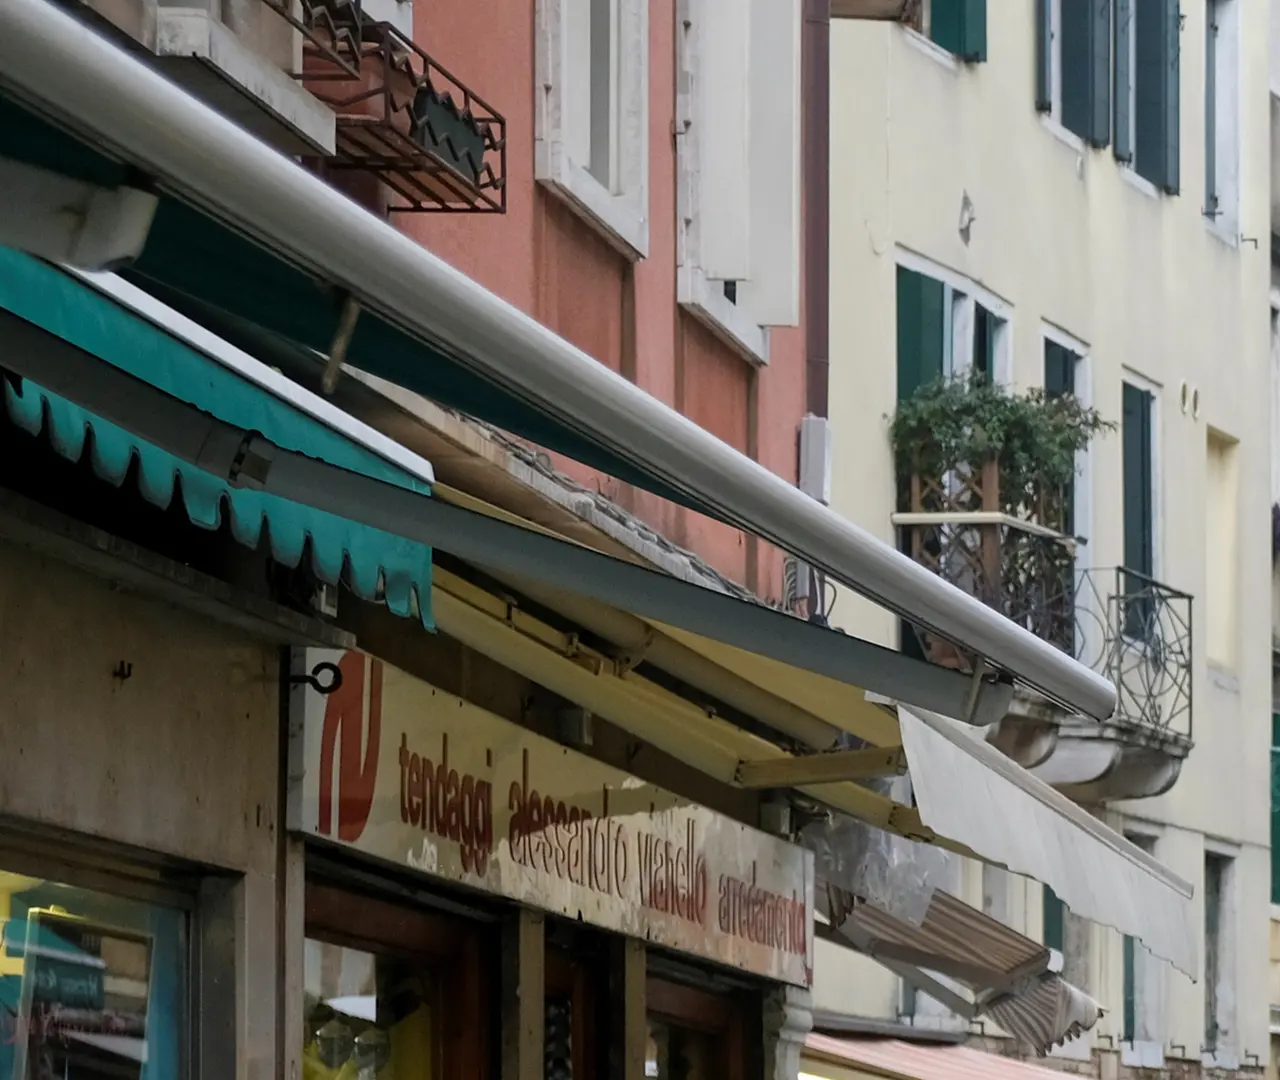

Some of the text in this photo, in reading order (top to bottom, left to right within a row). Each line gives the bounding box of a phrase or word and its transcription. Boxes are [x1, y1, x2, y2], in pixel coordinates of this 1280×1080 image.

[399, 732, 493, 877] tendaggi
[509, 748, 627, 899] alessandro
[637, 801, 707, 925] vianello
